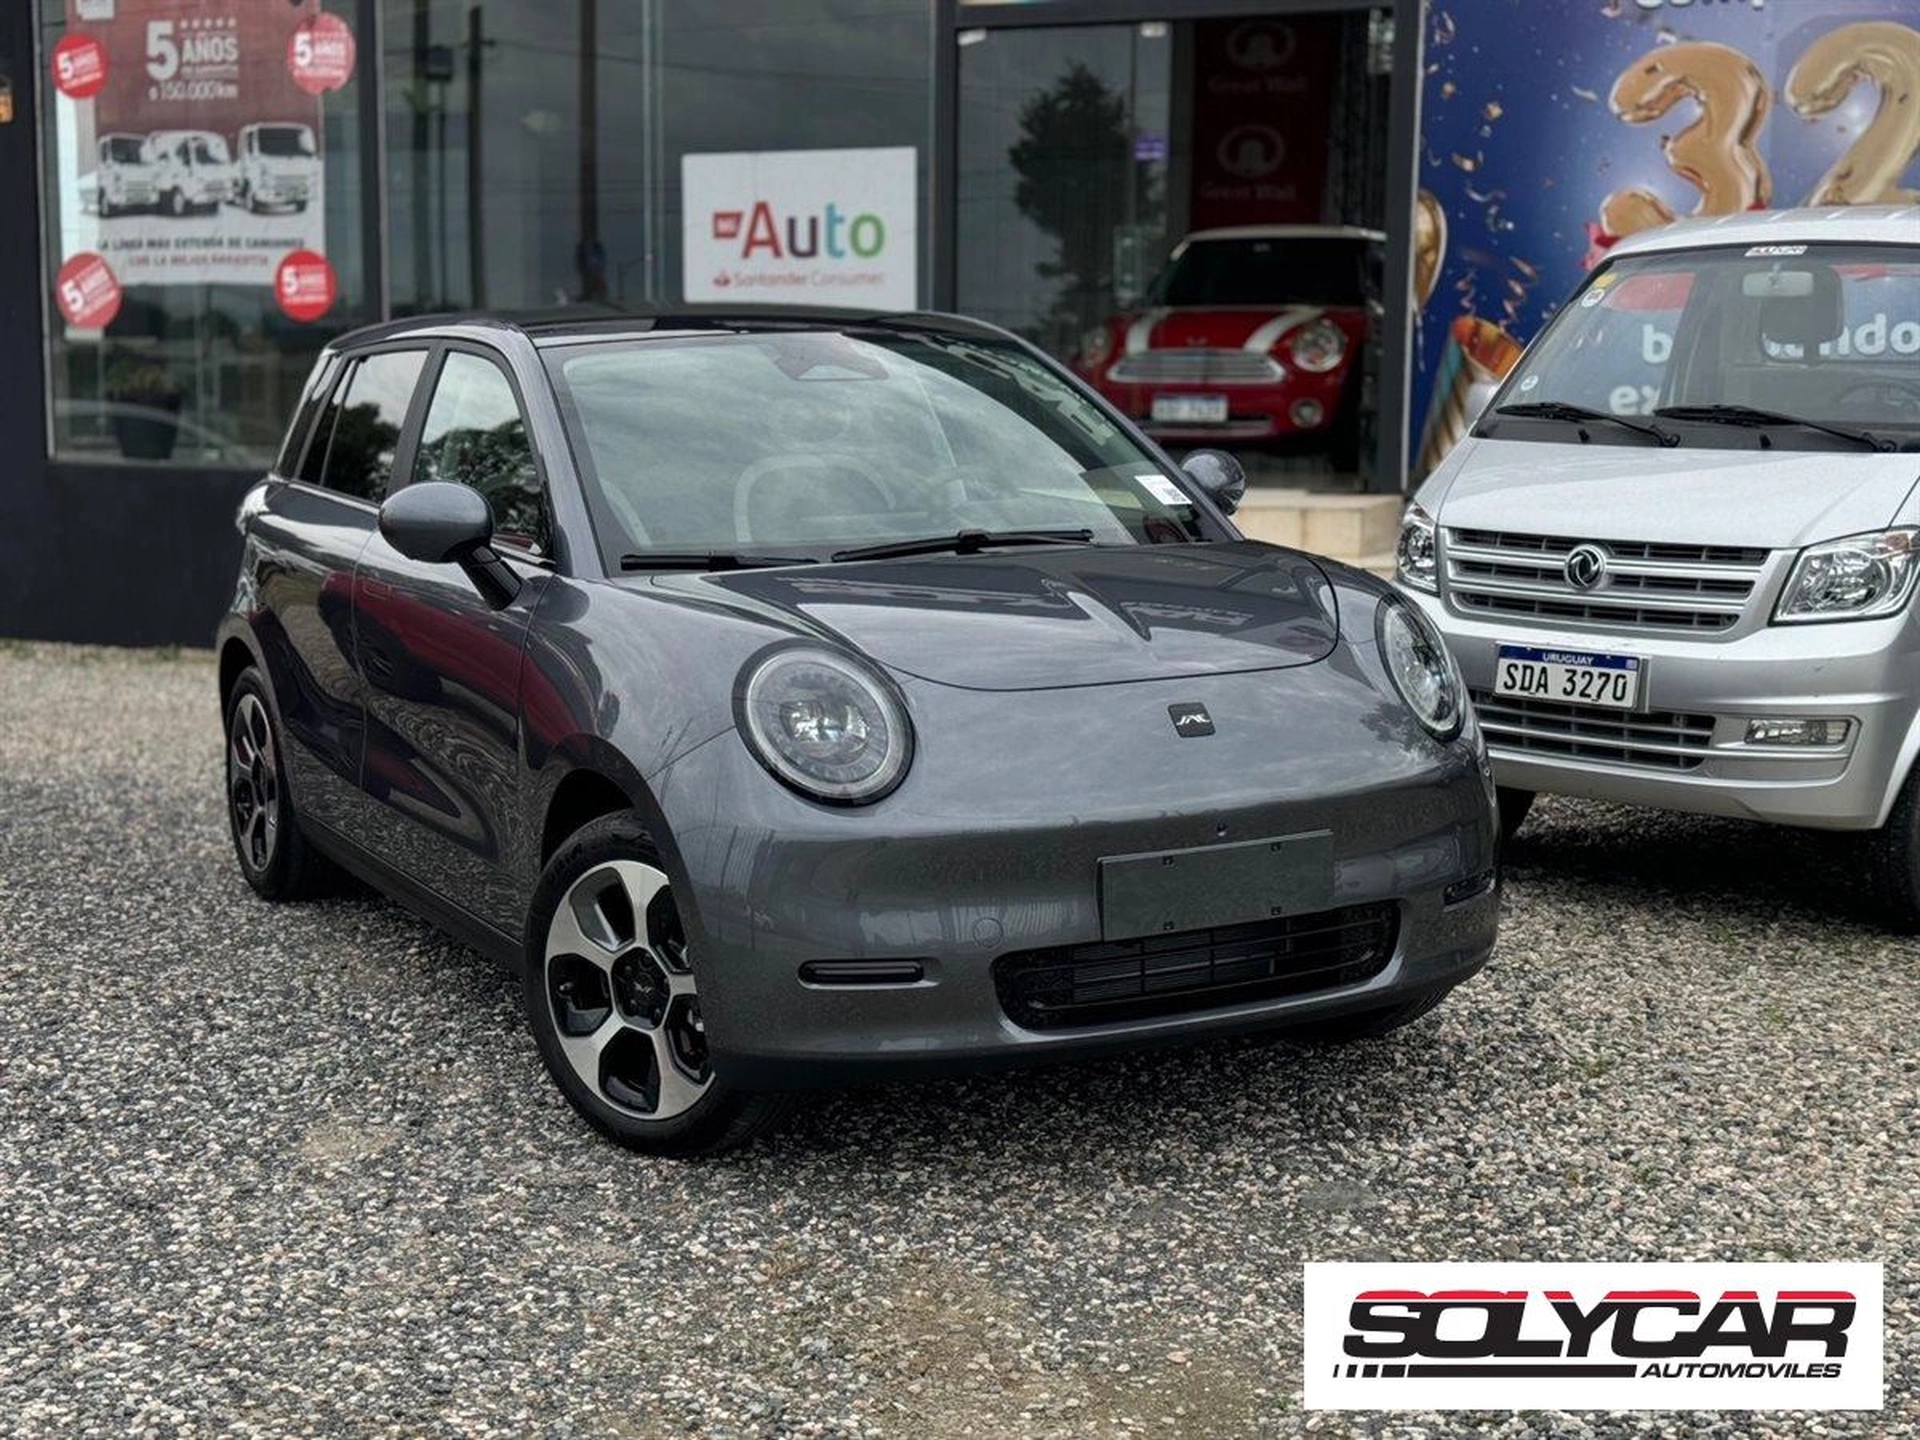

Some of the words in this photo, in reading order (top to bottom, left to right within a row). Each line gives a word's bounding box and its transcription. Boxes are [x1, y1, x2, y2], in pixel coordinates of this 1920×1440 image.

[57, 51, 74, 80] 5
[147, 20, 179, 80] 5
[182, 32, 238, 63] AÑOS
[294, 31, 311, 67] 5
[1600, 20, 1920, 235] 32
[742, 201, 885, 258] Auto
[62, 279, 83, 313] 5
[282, 265, 298, 295] 5
[734, 271, 806, 287] Santander
[811, 270, 885, 287] Consumer
[1541, 652, 1594, 666] URUGUAY
[1503, 663, 1549, 695] SDA
[1562, 668, 1628, 702] 3270
